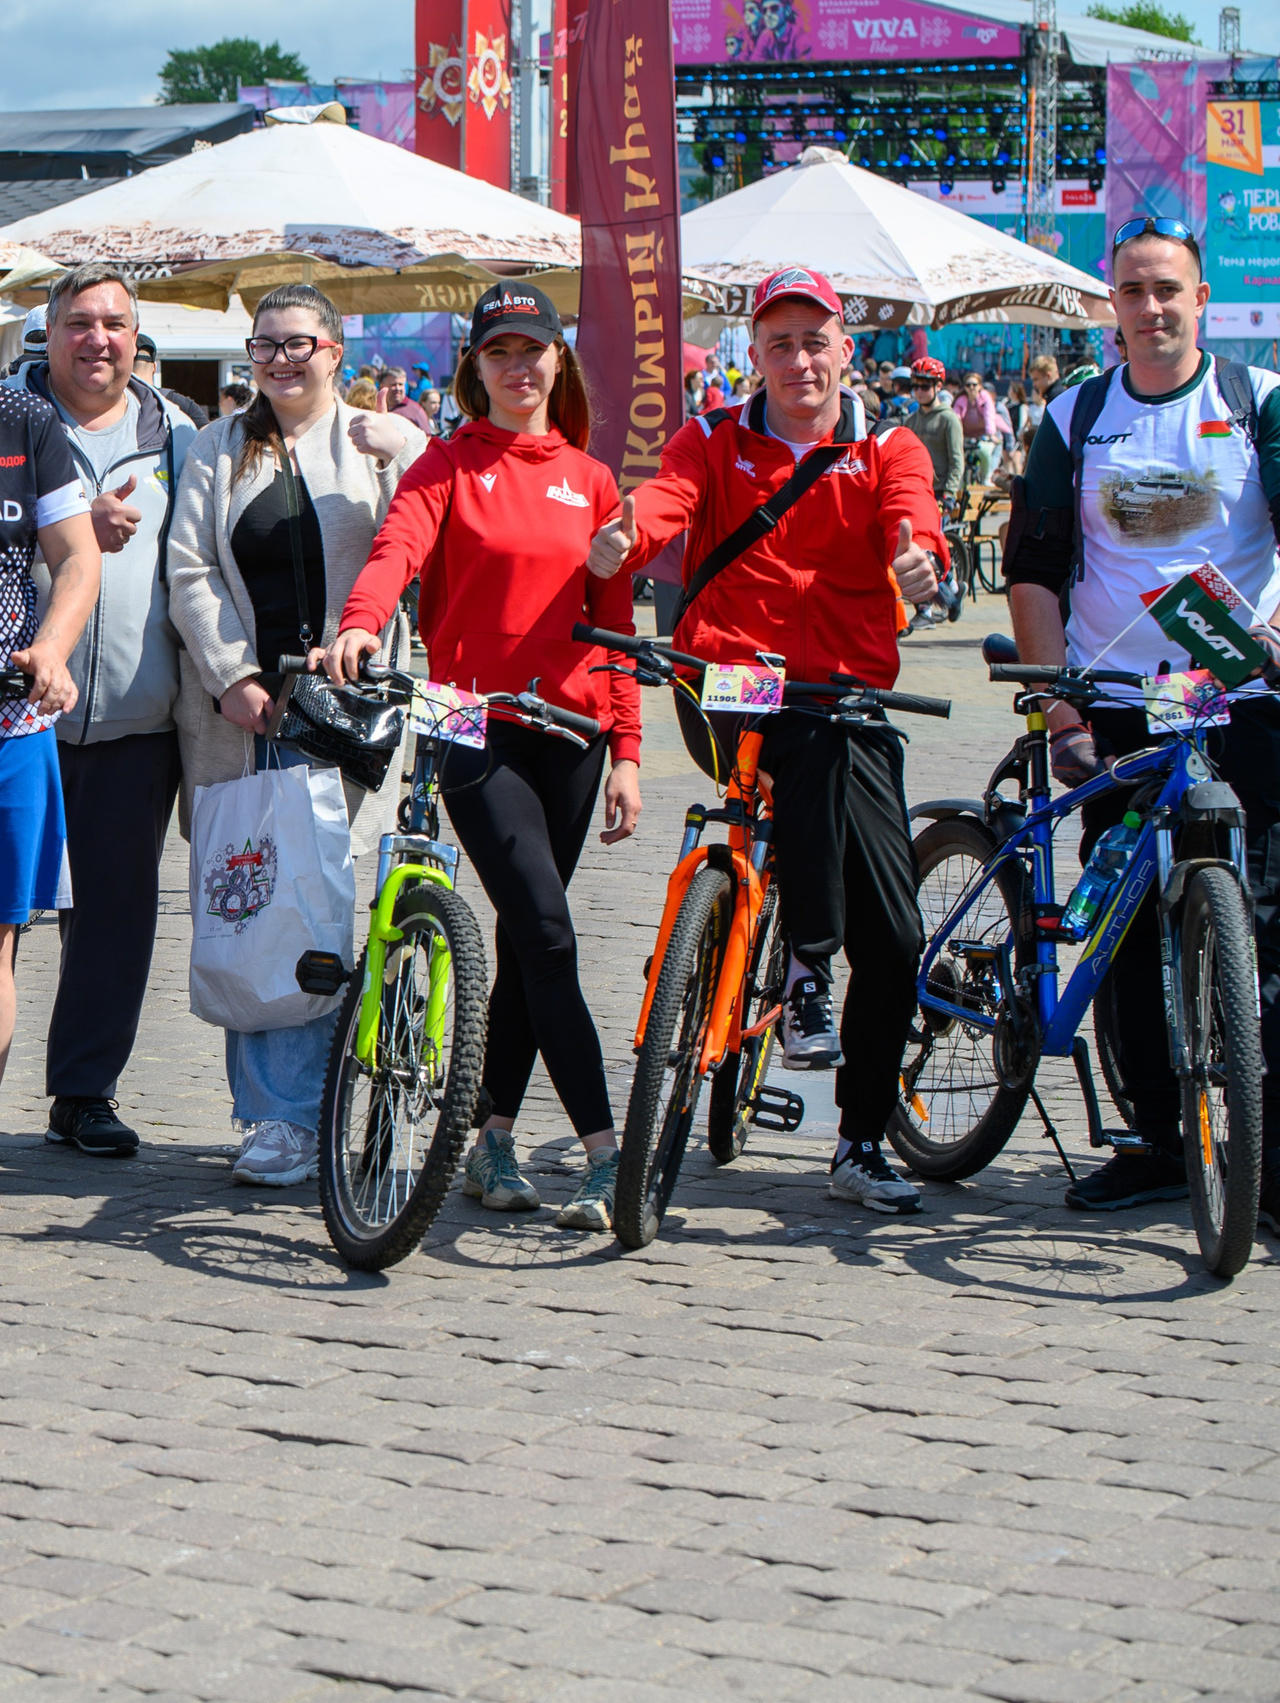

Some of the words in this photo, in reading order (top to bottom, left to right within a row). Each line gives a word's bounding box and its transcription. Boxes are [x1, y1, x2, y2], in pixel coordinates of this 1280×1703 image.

[852, 16, 918, 39] VIVA
[1220, 108, 1246, 135] 31
[1248, 212, 1280, 231] РОВ
[1218, 255, 1246, 267] Тема
[1243, 274, 1280, 287] Карна
[1085, 432, 1133, 447] OLAT
[1176, 598, 1246, 661] VOLAT
[1091, 859, 1155, 975] AUTHOR
